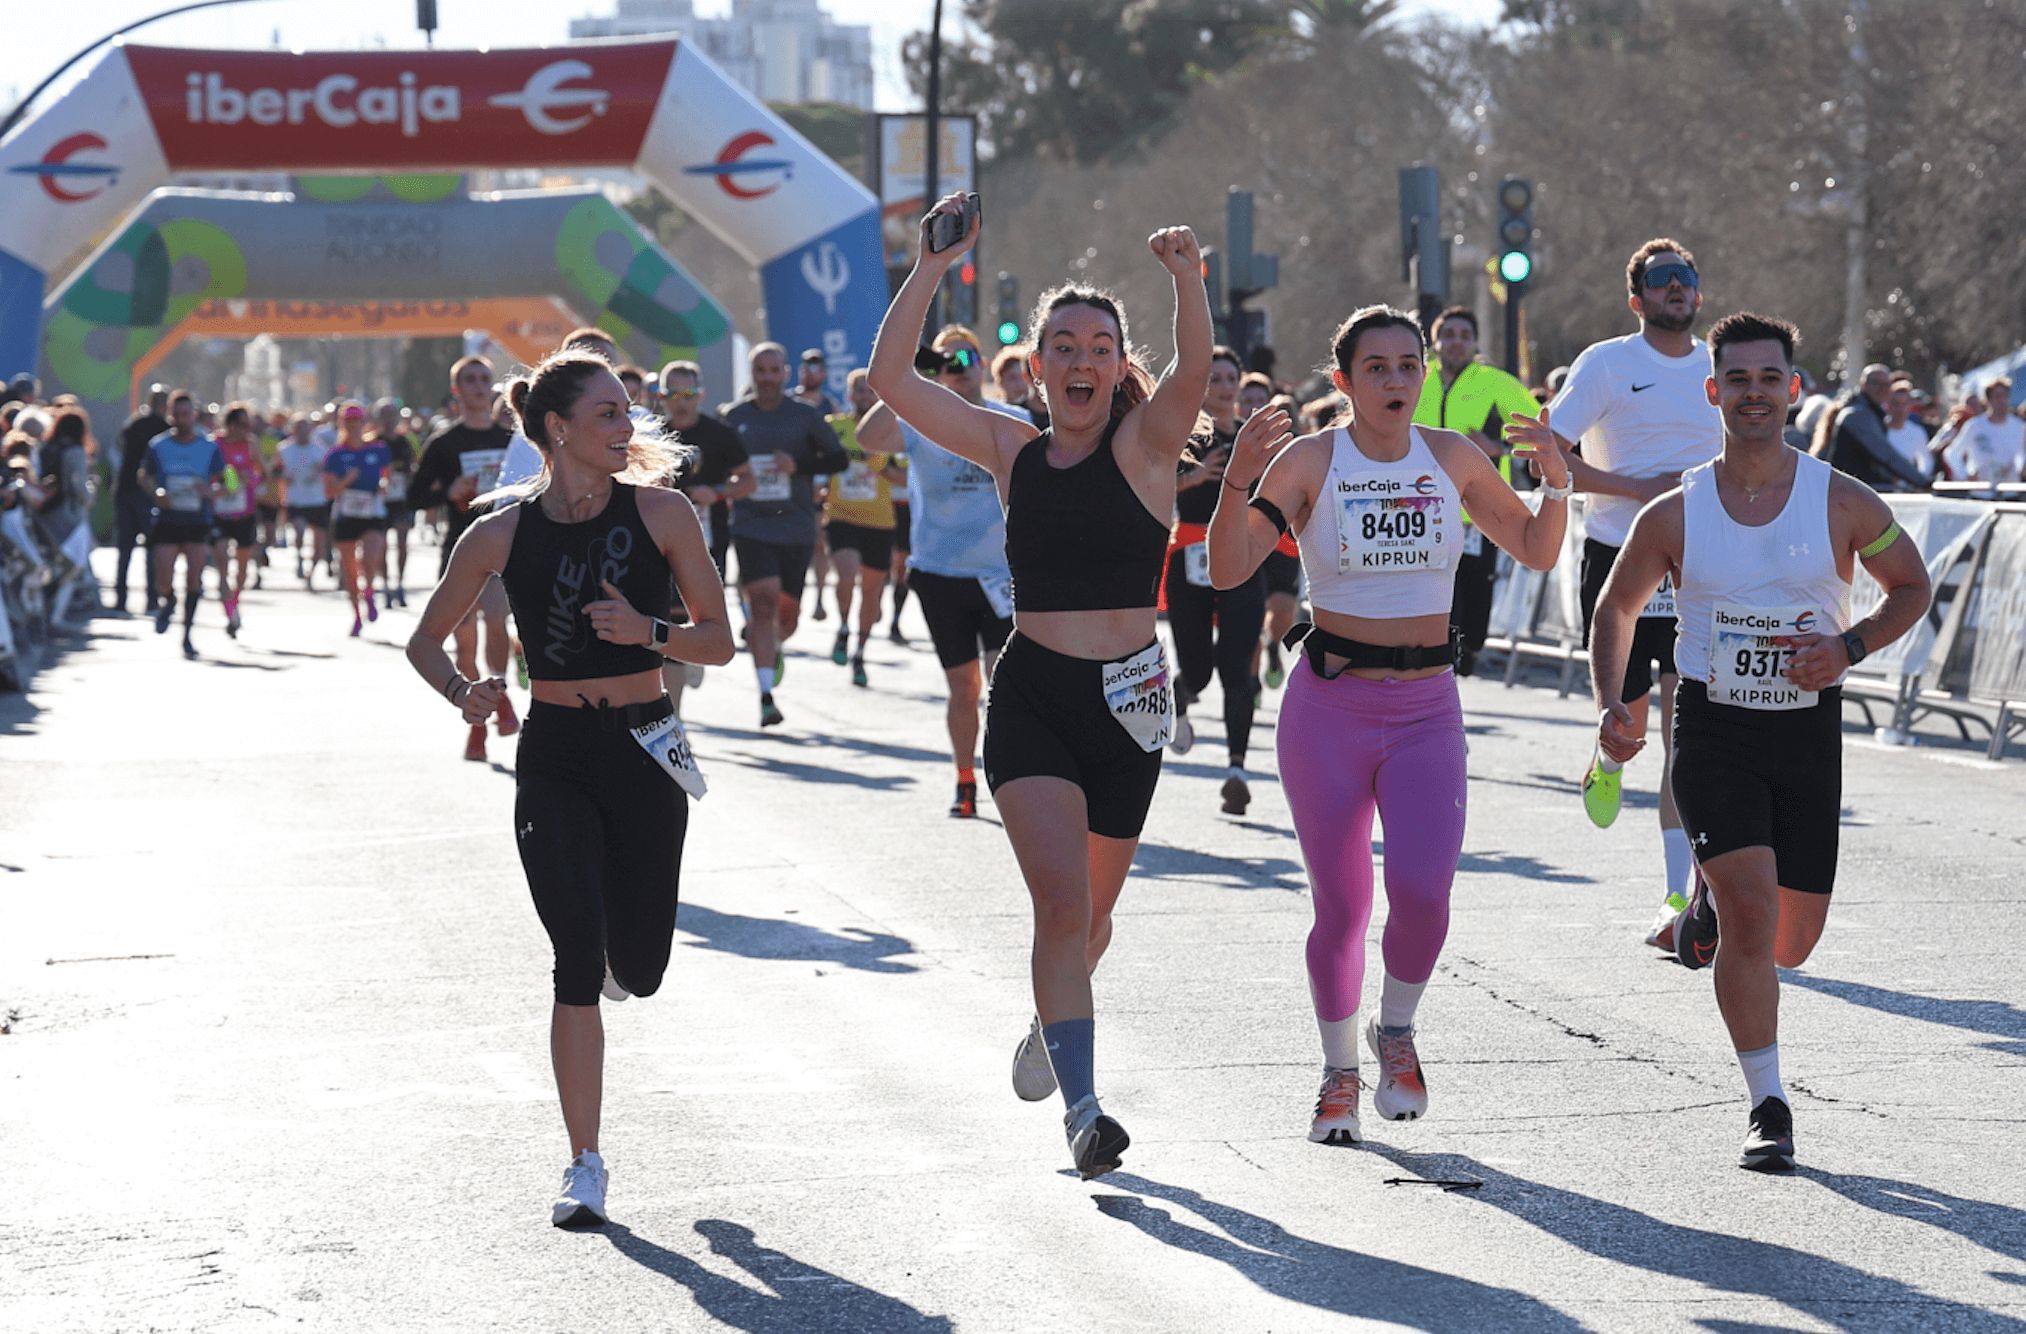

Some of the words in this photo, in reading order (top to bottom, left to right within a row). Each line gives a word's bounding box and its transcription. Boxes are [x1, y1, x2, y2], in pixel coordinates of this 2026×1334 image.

[186, 71, 461, 137] iberCaja
[1338, 479, 1401, 494] iberCaja
[1361, 511, 1426, 540] 8409
[1435, 531, 1443, 544] 9
[1362, 550, 1429, 567] KIPRUN
[544, 554, 587, 667] NIKE
[1643, 602, 1674, 613] KIPR
[1716, 611, 1780, 631] iberCaja
[1730, 688, 1798, 704] KIPRUN
